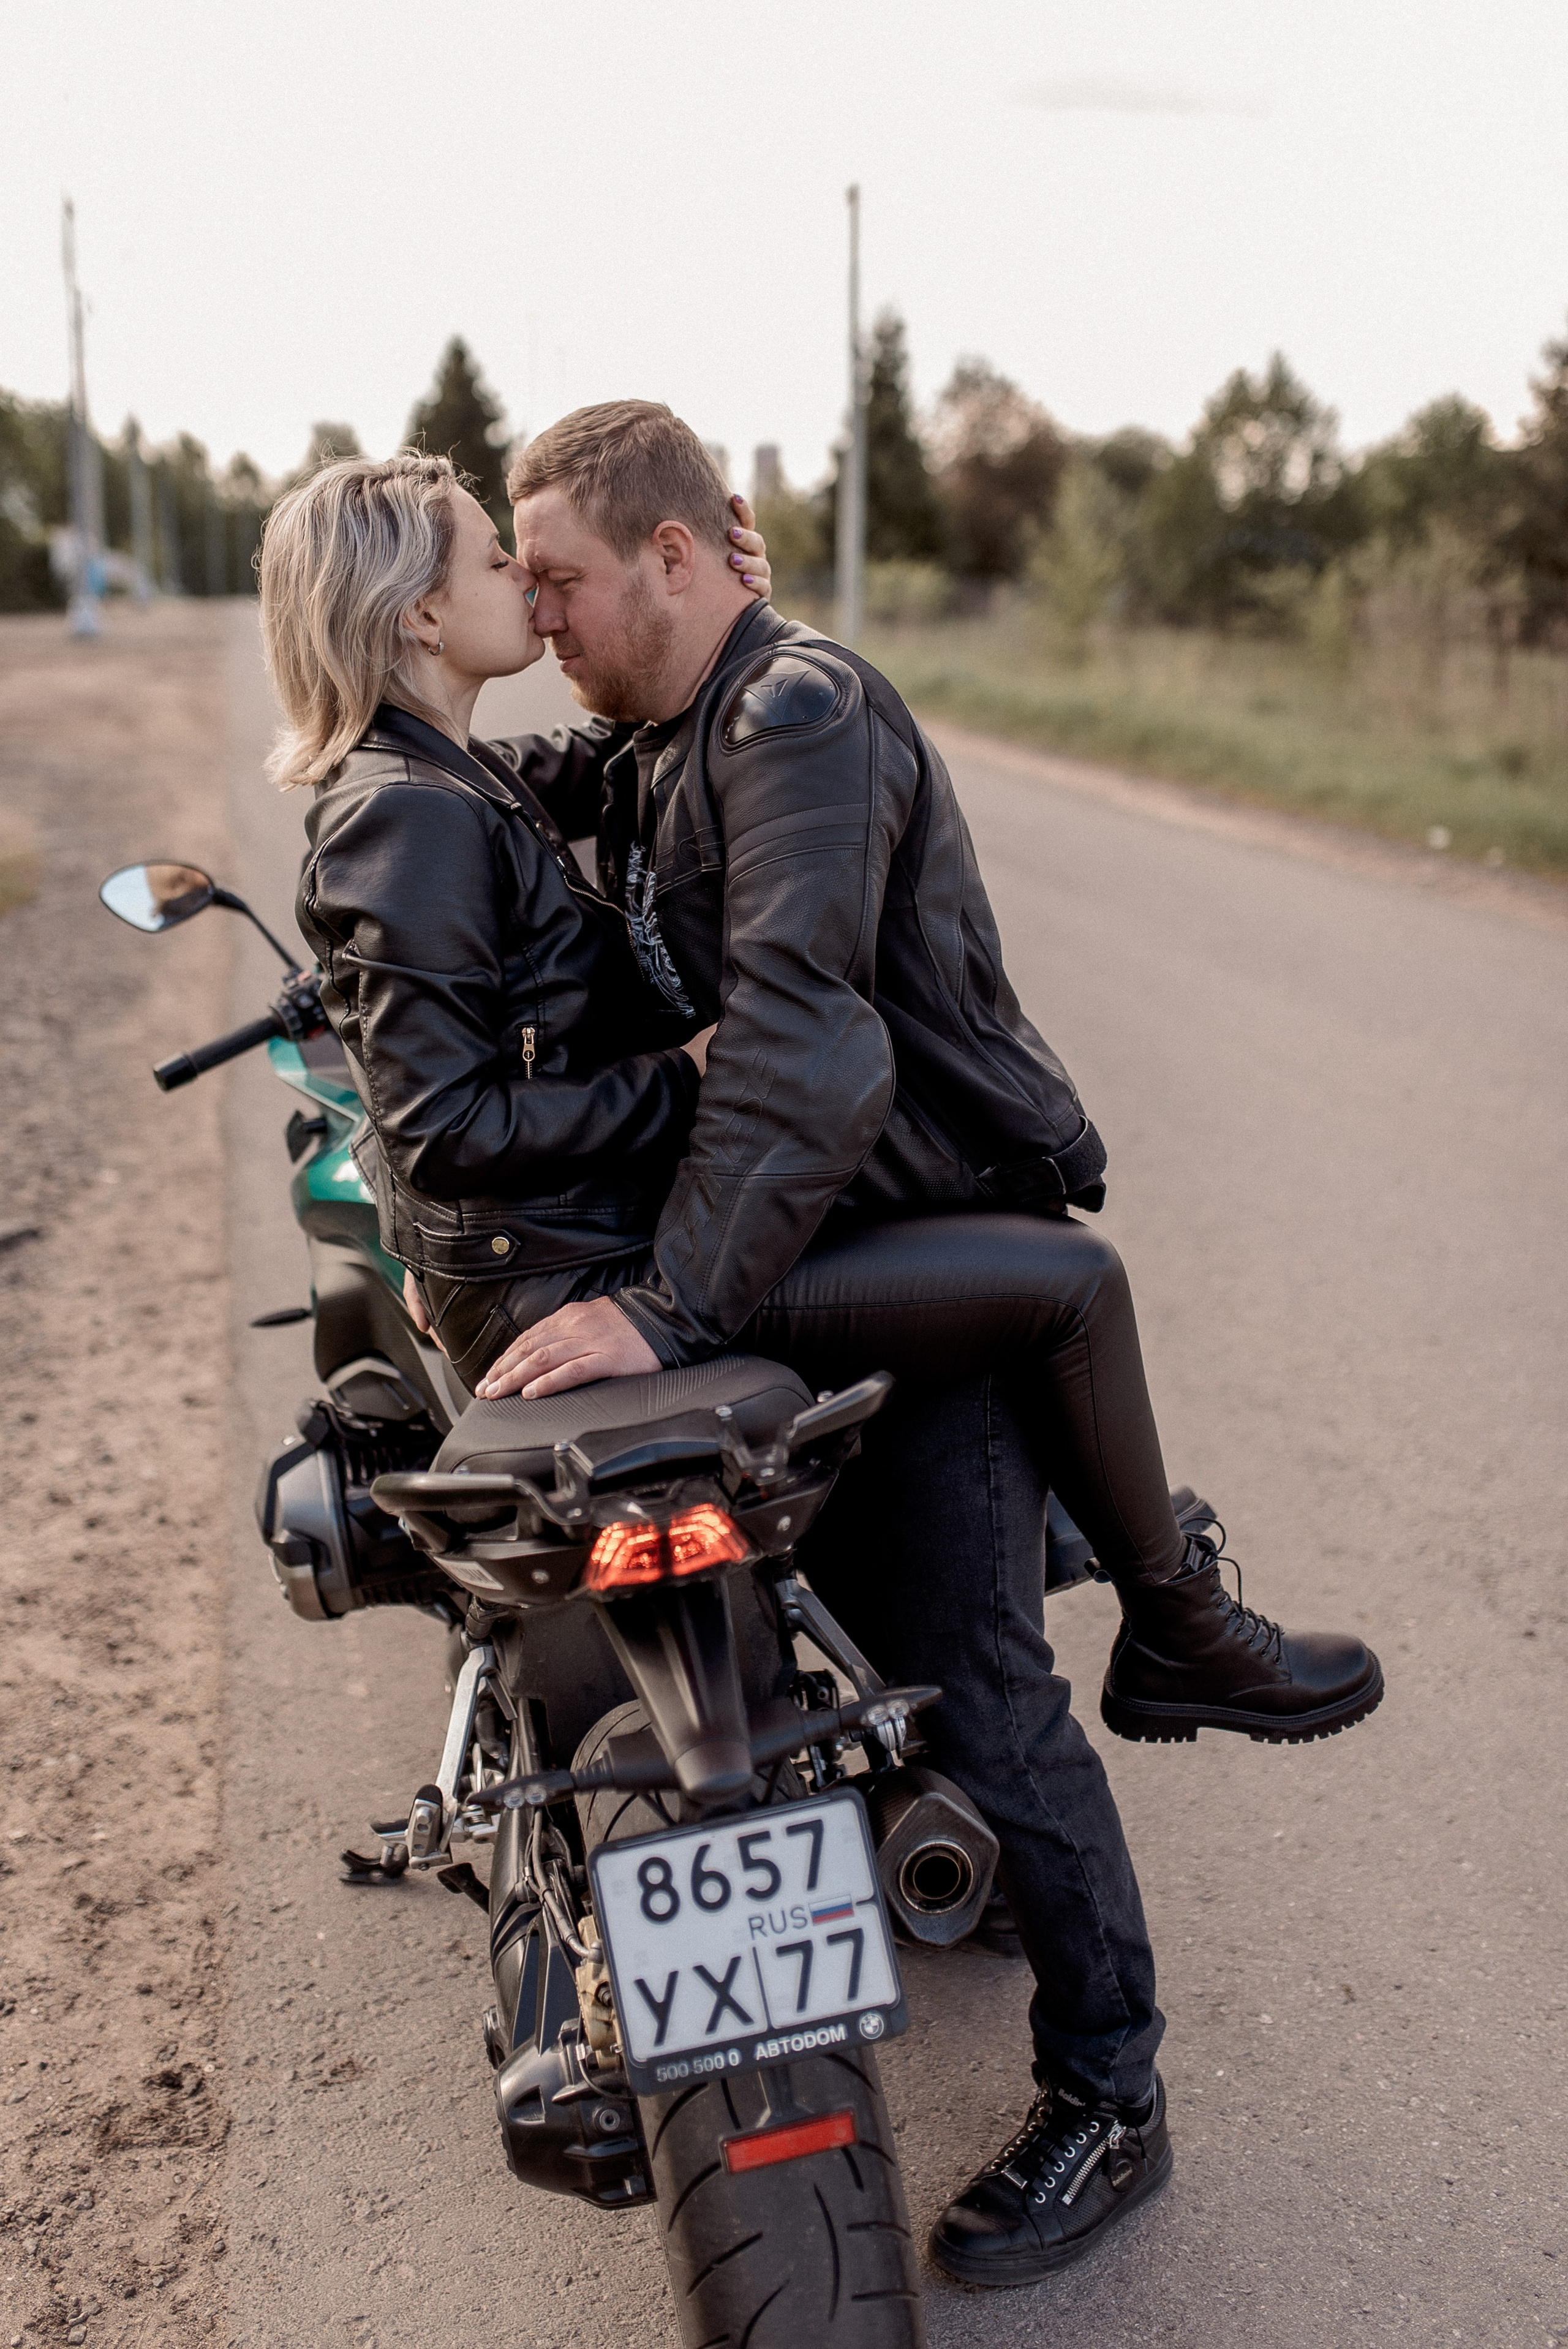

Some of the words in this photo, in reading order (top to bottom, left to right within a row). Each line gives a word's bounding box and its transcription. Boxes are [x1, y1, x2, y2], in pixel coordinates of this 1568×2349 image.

[637, 1819, 824, 1922] 8657
[748, 1907, 808, 1940] RUS
[775, 1928, 864, 2013] 77
[657, 2063, 689, 2083] 500
[693, 2056, 726, 2075] 500
